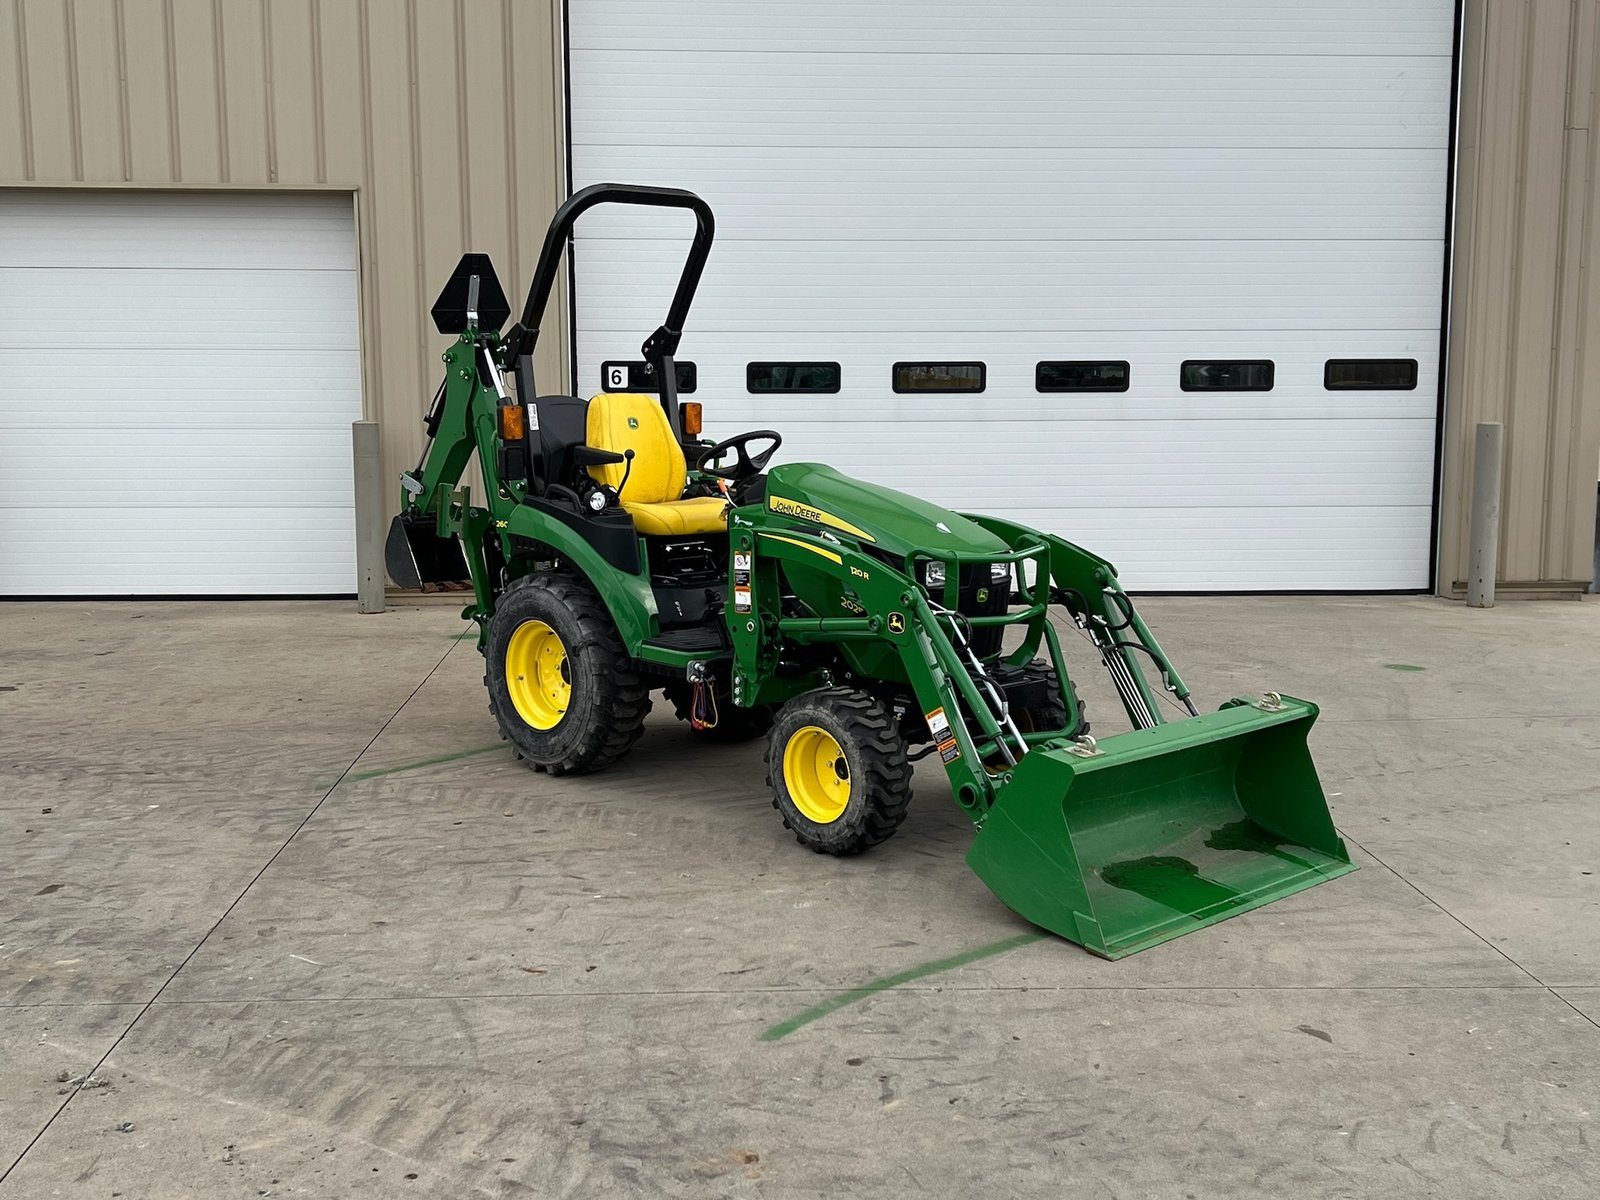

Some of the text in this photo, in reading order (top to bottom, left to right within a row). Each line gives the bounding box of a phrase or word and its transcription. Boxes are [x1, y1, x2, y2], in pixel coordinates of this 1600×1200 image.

[611, 369, 622, 385] 6
[774, 501, 822, 521] JOHN DEERE
